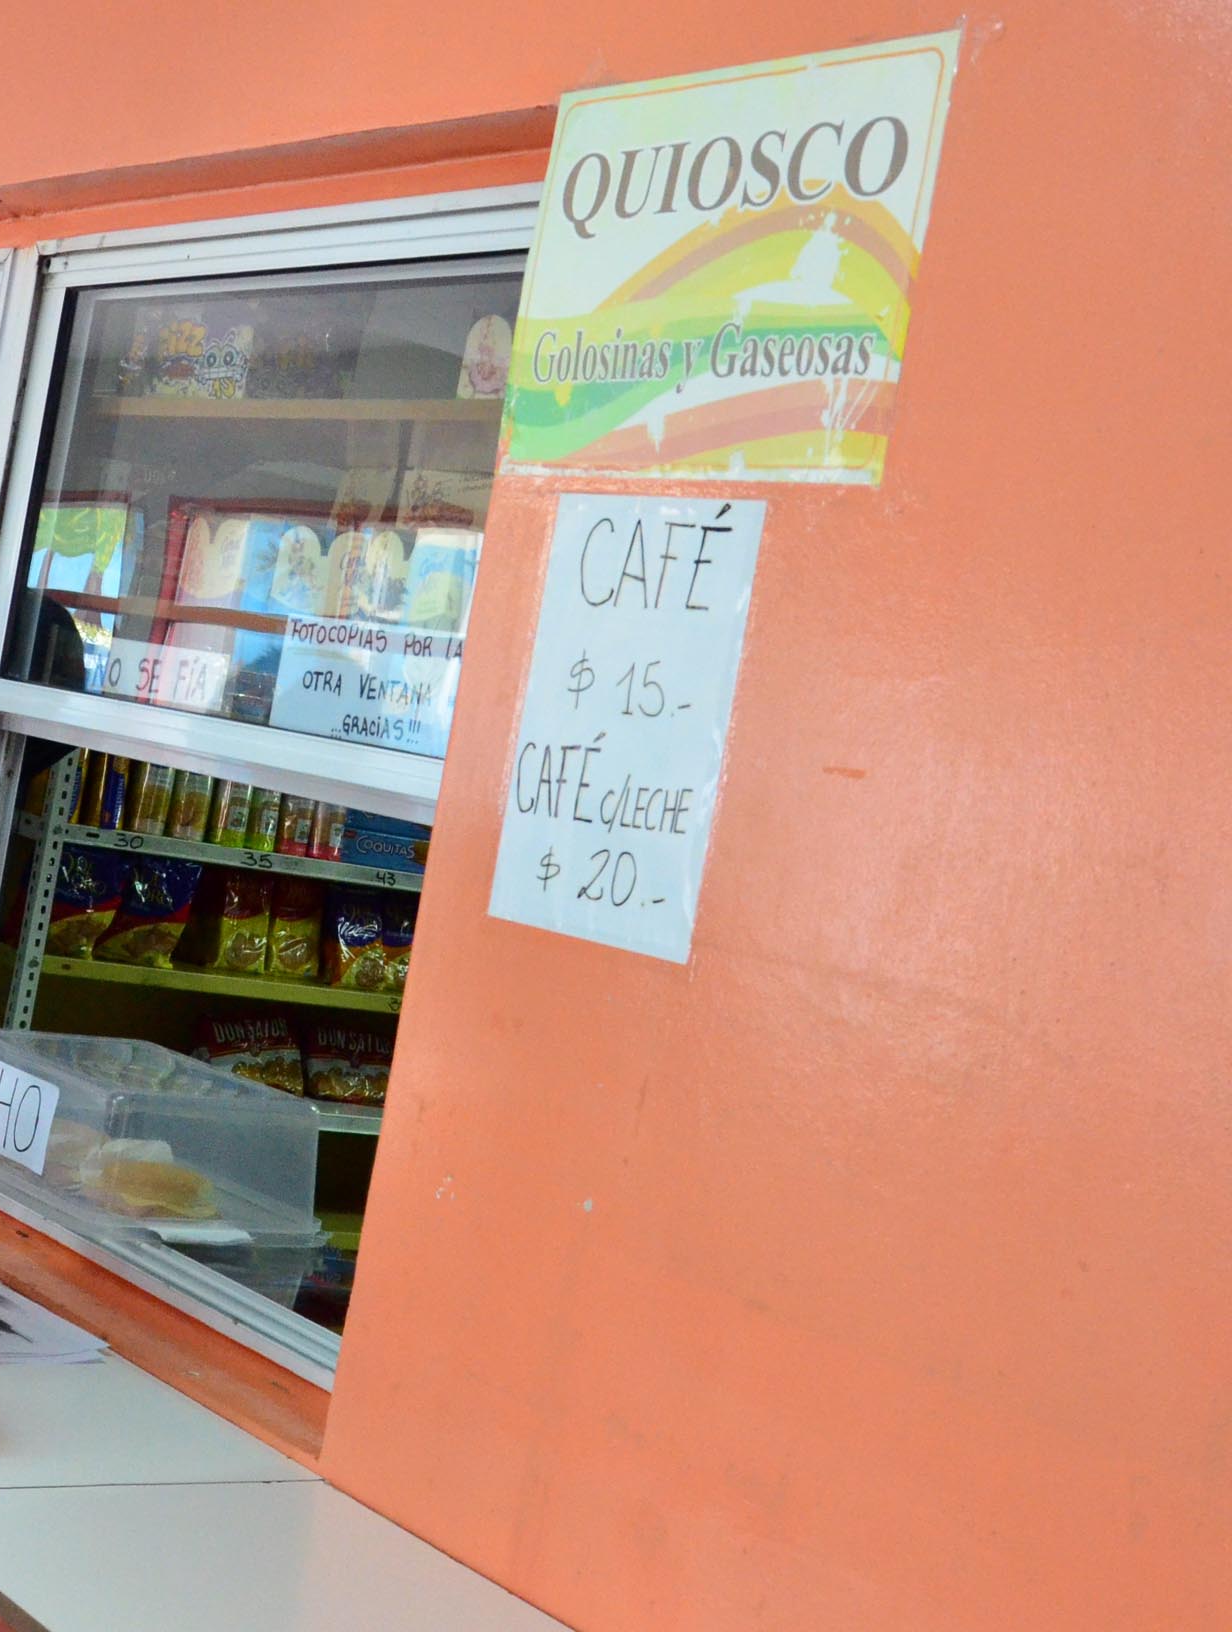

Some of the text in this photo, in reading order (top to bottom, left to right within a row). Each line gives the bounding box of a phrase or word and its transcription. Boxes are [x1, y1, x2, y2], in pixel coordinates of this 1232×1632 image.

[561, 115, 910, 240] QUIOSCO
[532, 321, 876, 394] Golosinas y Gaseosas
[580, 503, 733, 611] CAFÉ
[290, 618, 388, 654] FOTOCOPIAS
[403, 634, 433, 659] POR
[135, 658, 162, 694] SE
[302, 669, 432, 709] OTRA VENTANA
[567, 649, 596, 710] $
[516, 731, 606, 824] CAFÉ
[114, 833, 144, 850] 30
[240, 851, 274, 869] 35
[355, 834, 416, 859] COQUITAS
[375, 871, 397, 886] 43
[537, 846, 561, 892] $
